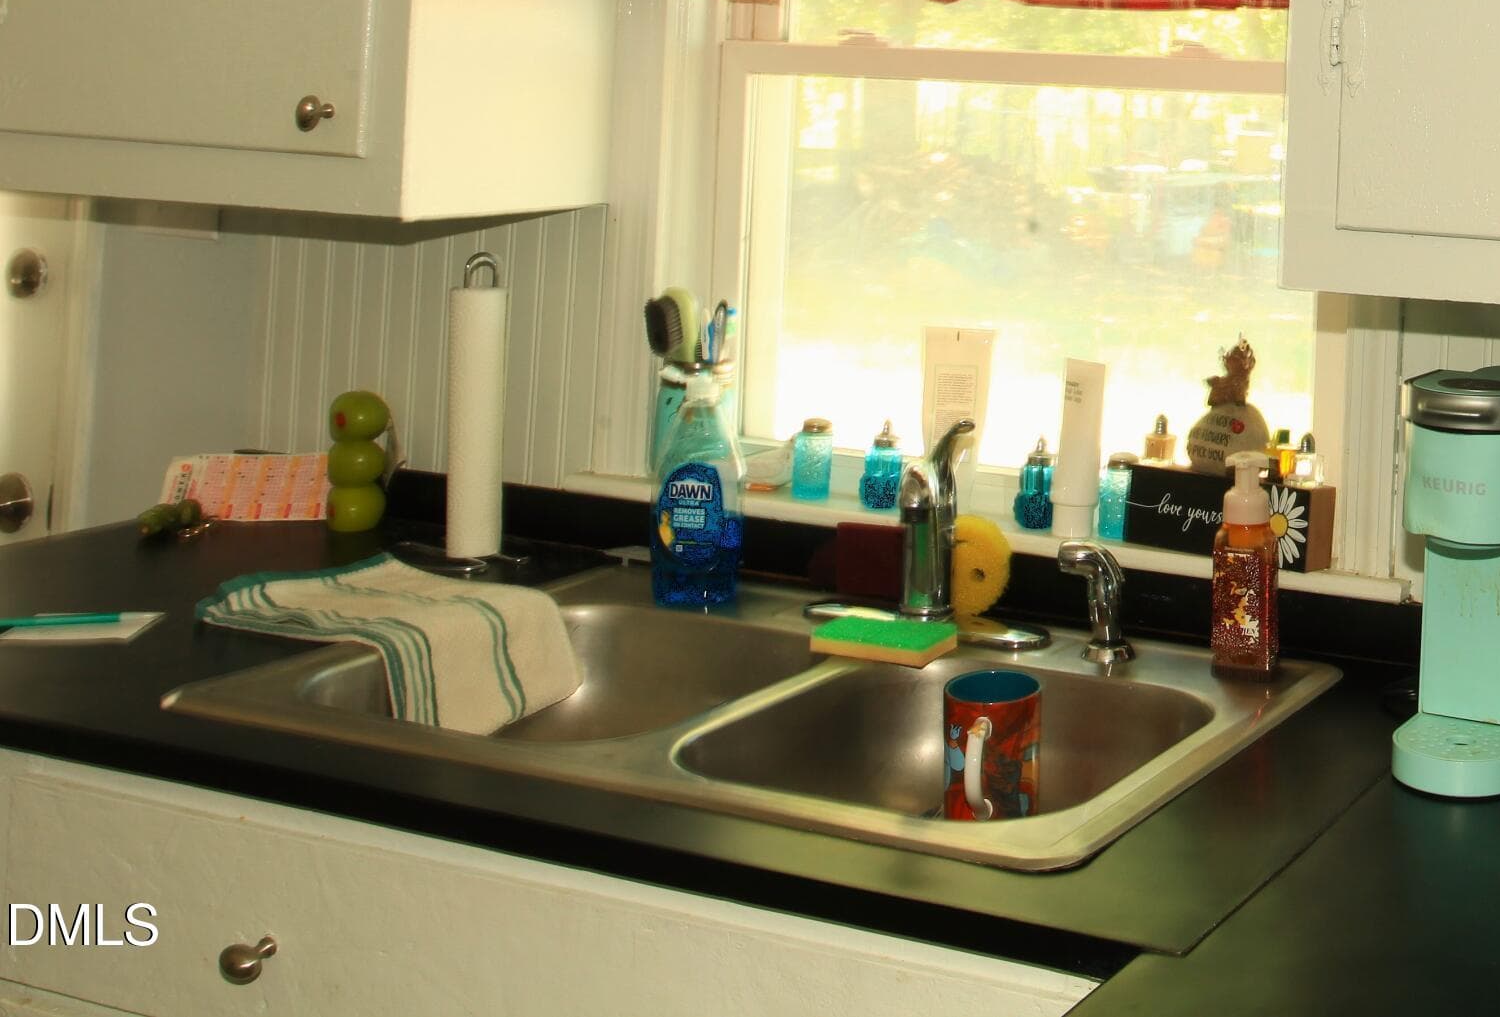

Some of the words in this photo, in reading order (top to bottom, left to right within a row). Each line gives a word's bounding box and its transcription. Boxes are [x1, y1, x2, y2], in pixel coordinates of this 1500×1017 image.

[1208, 447, 1225, 461] YOU
[670, 483, 712, 500] DAWN
[1422, 476, 1488, 496] KEURIG
[673, 507, 706, 515] REMOVES
[673, 514, 706, 523] GREASE
[1158, 492, 1183, 517] love
[1182, 507, 1224, 533] yours
